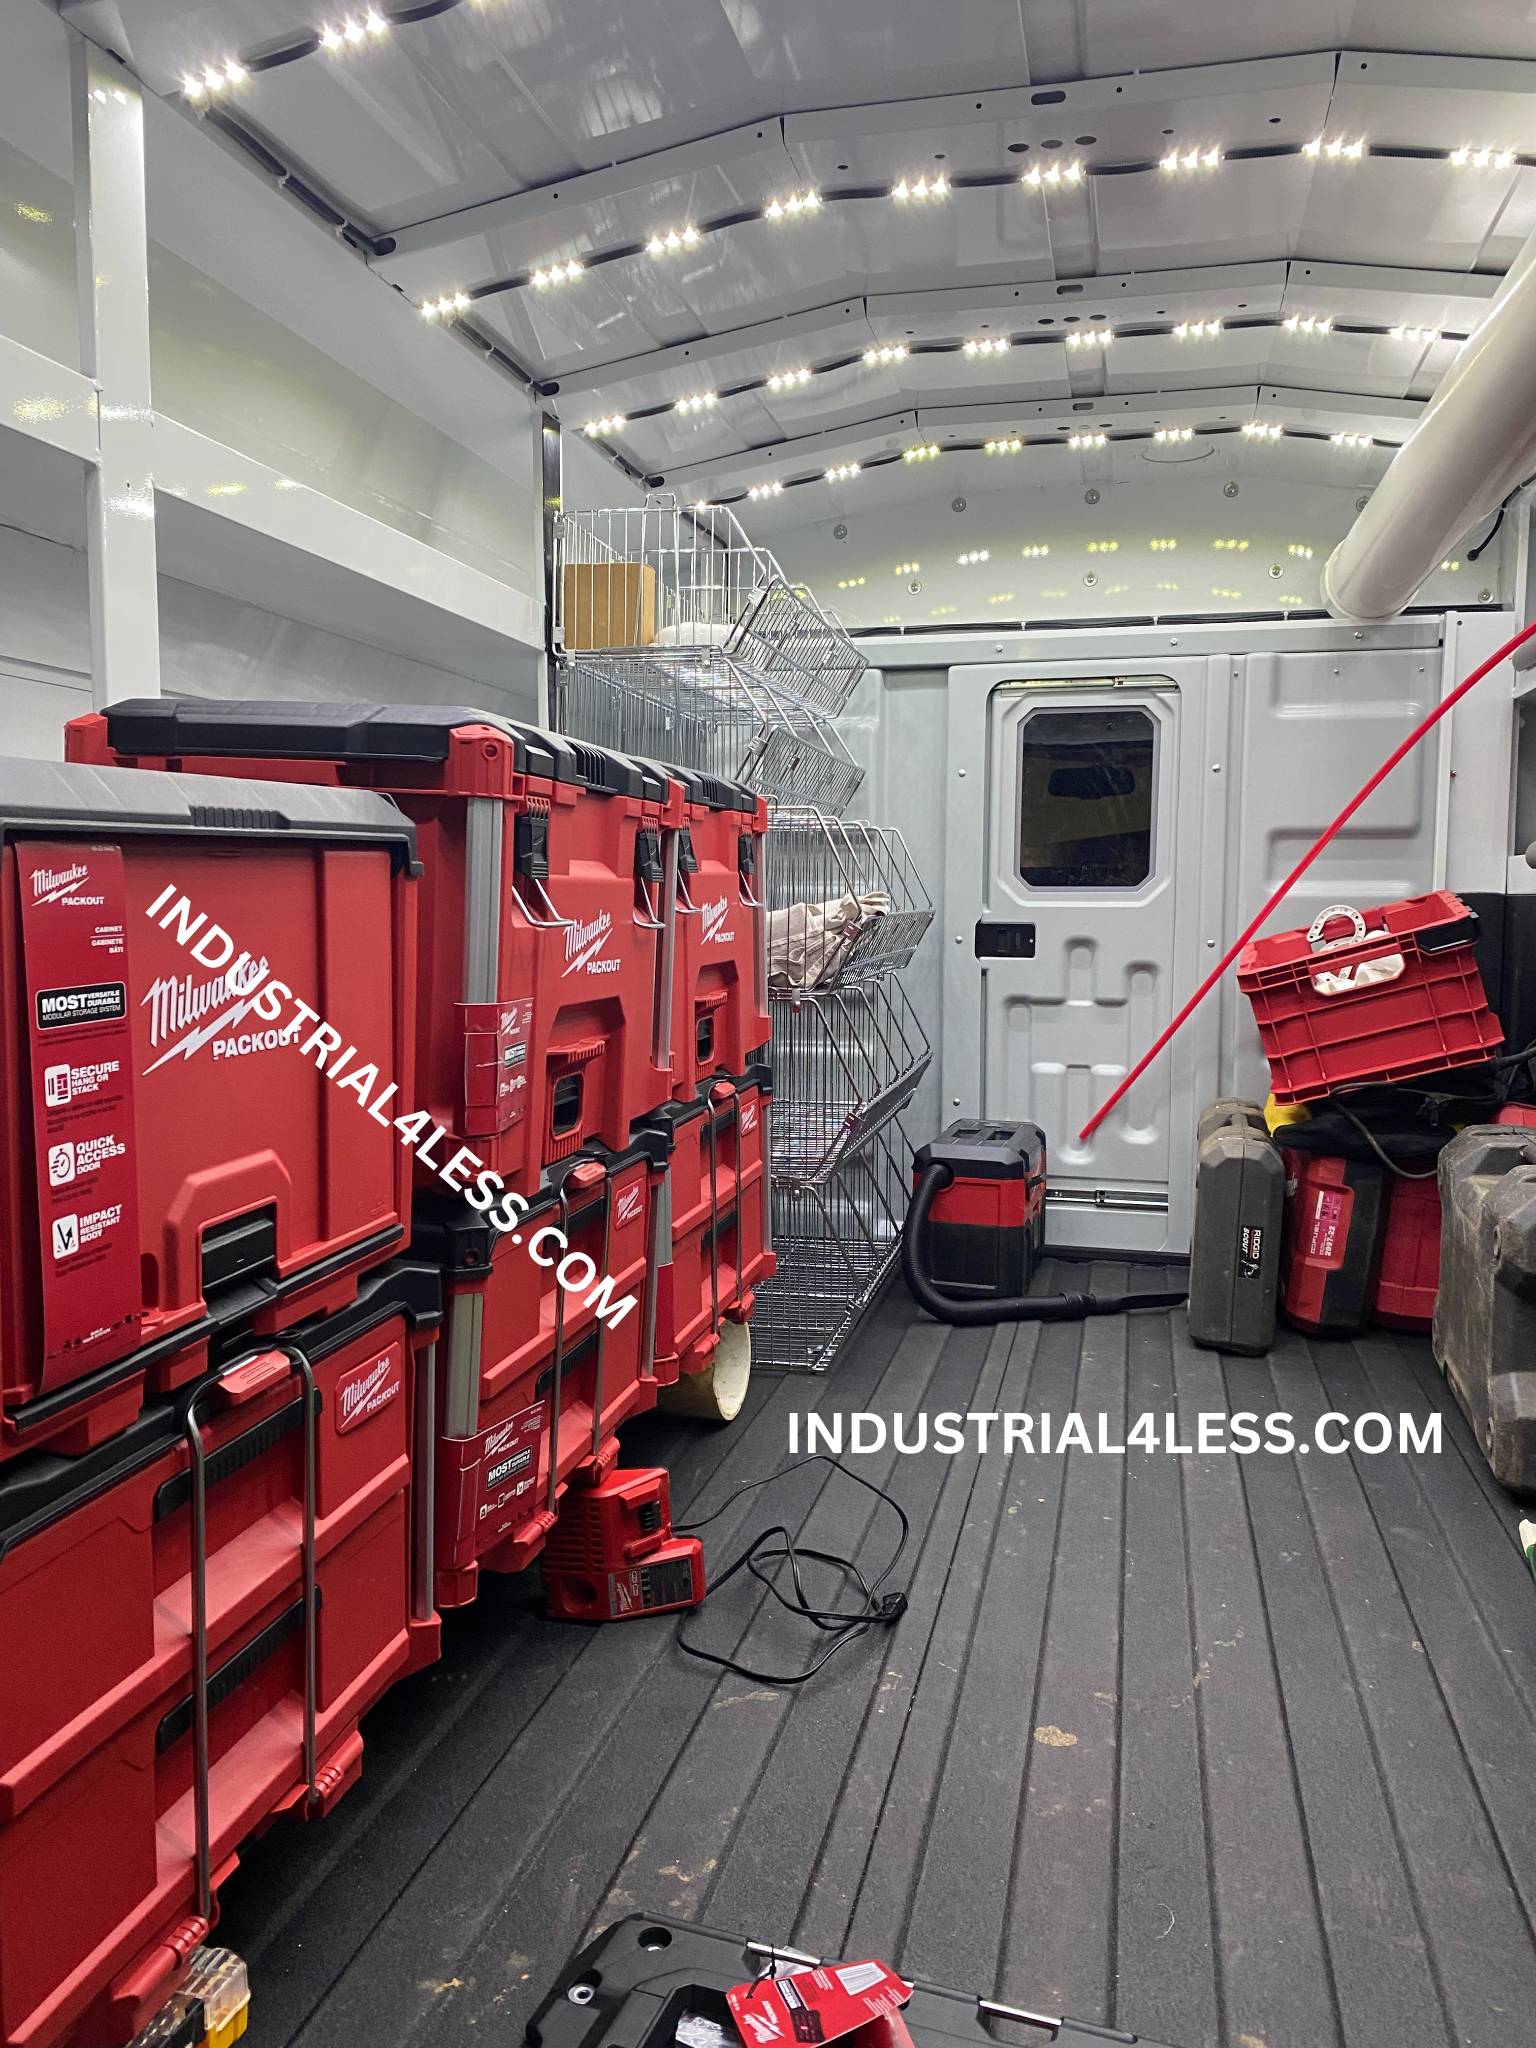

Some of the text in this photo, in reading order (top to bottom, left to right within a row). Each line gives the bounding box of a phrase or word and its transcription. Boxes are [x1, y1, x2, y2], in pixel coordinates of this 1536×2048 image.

[29, 863, 88, 897] Milwaukee
[61, 896, 105, 906] PACKOUT
[95, 925, 123, 933] CABINET
[562, 909, 612, 962] Milwaukee
[586, 958, 621, 975] PACKOUT
[41, 993, 88, 1014] MOST
[87, 989, 120, 999] VERSATILE
[87, 996, 120, 1007] DURABLE
[42, 1010, 72, 1021] MODULAR
[72, 1006, 99, 1017] STORAGE
[71, 1060, 120, 1080] SECURE
[72, 1073, 109, 1088] HANG OR
[72, 1083, 99, 1096] STACK
[76, 1134, 115, 1154] QUICK
[76, 1142, 126, 1166] ACCESS
[76, 1161, 101, 1175] DOOR
[79, 1204, 122, 1228] IMPACT
[80, 1215, 121, 1236] RESISTANT
[80, 1229, 103, 1244] BODY
[1241, 1227, 1250, 1254] SCOUT
[1312, 1221, 1321, 1244] FUEL
[1252, 1229, 1262, 1260] RIDGID
[340, 1357, 390, 1417] Milwaukee
[366, 1380, 400, 1413] PACKOUT
[487, 1459, 513, 1483] MOST
